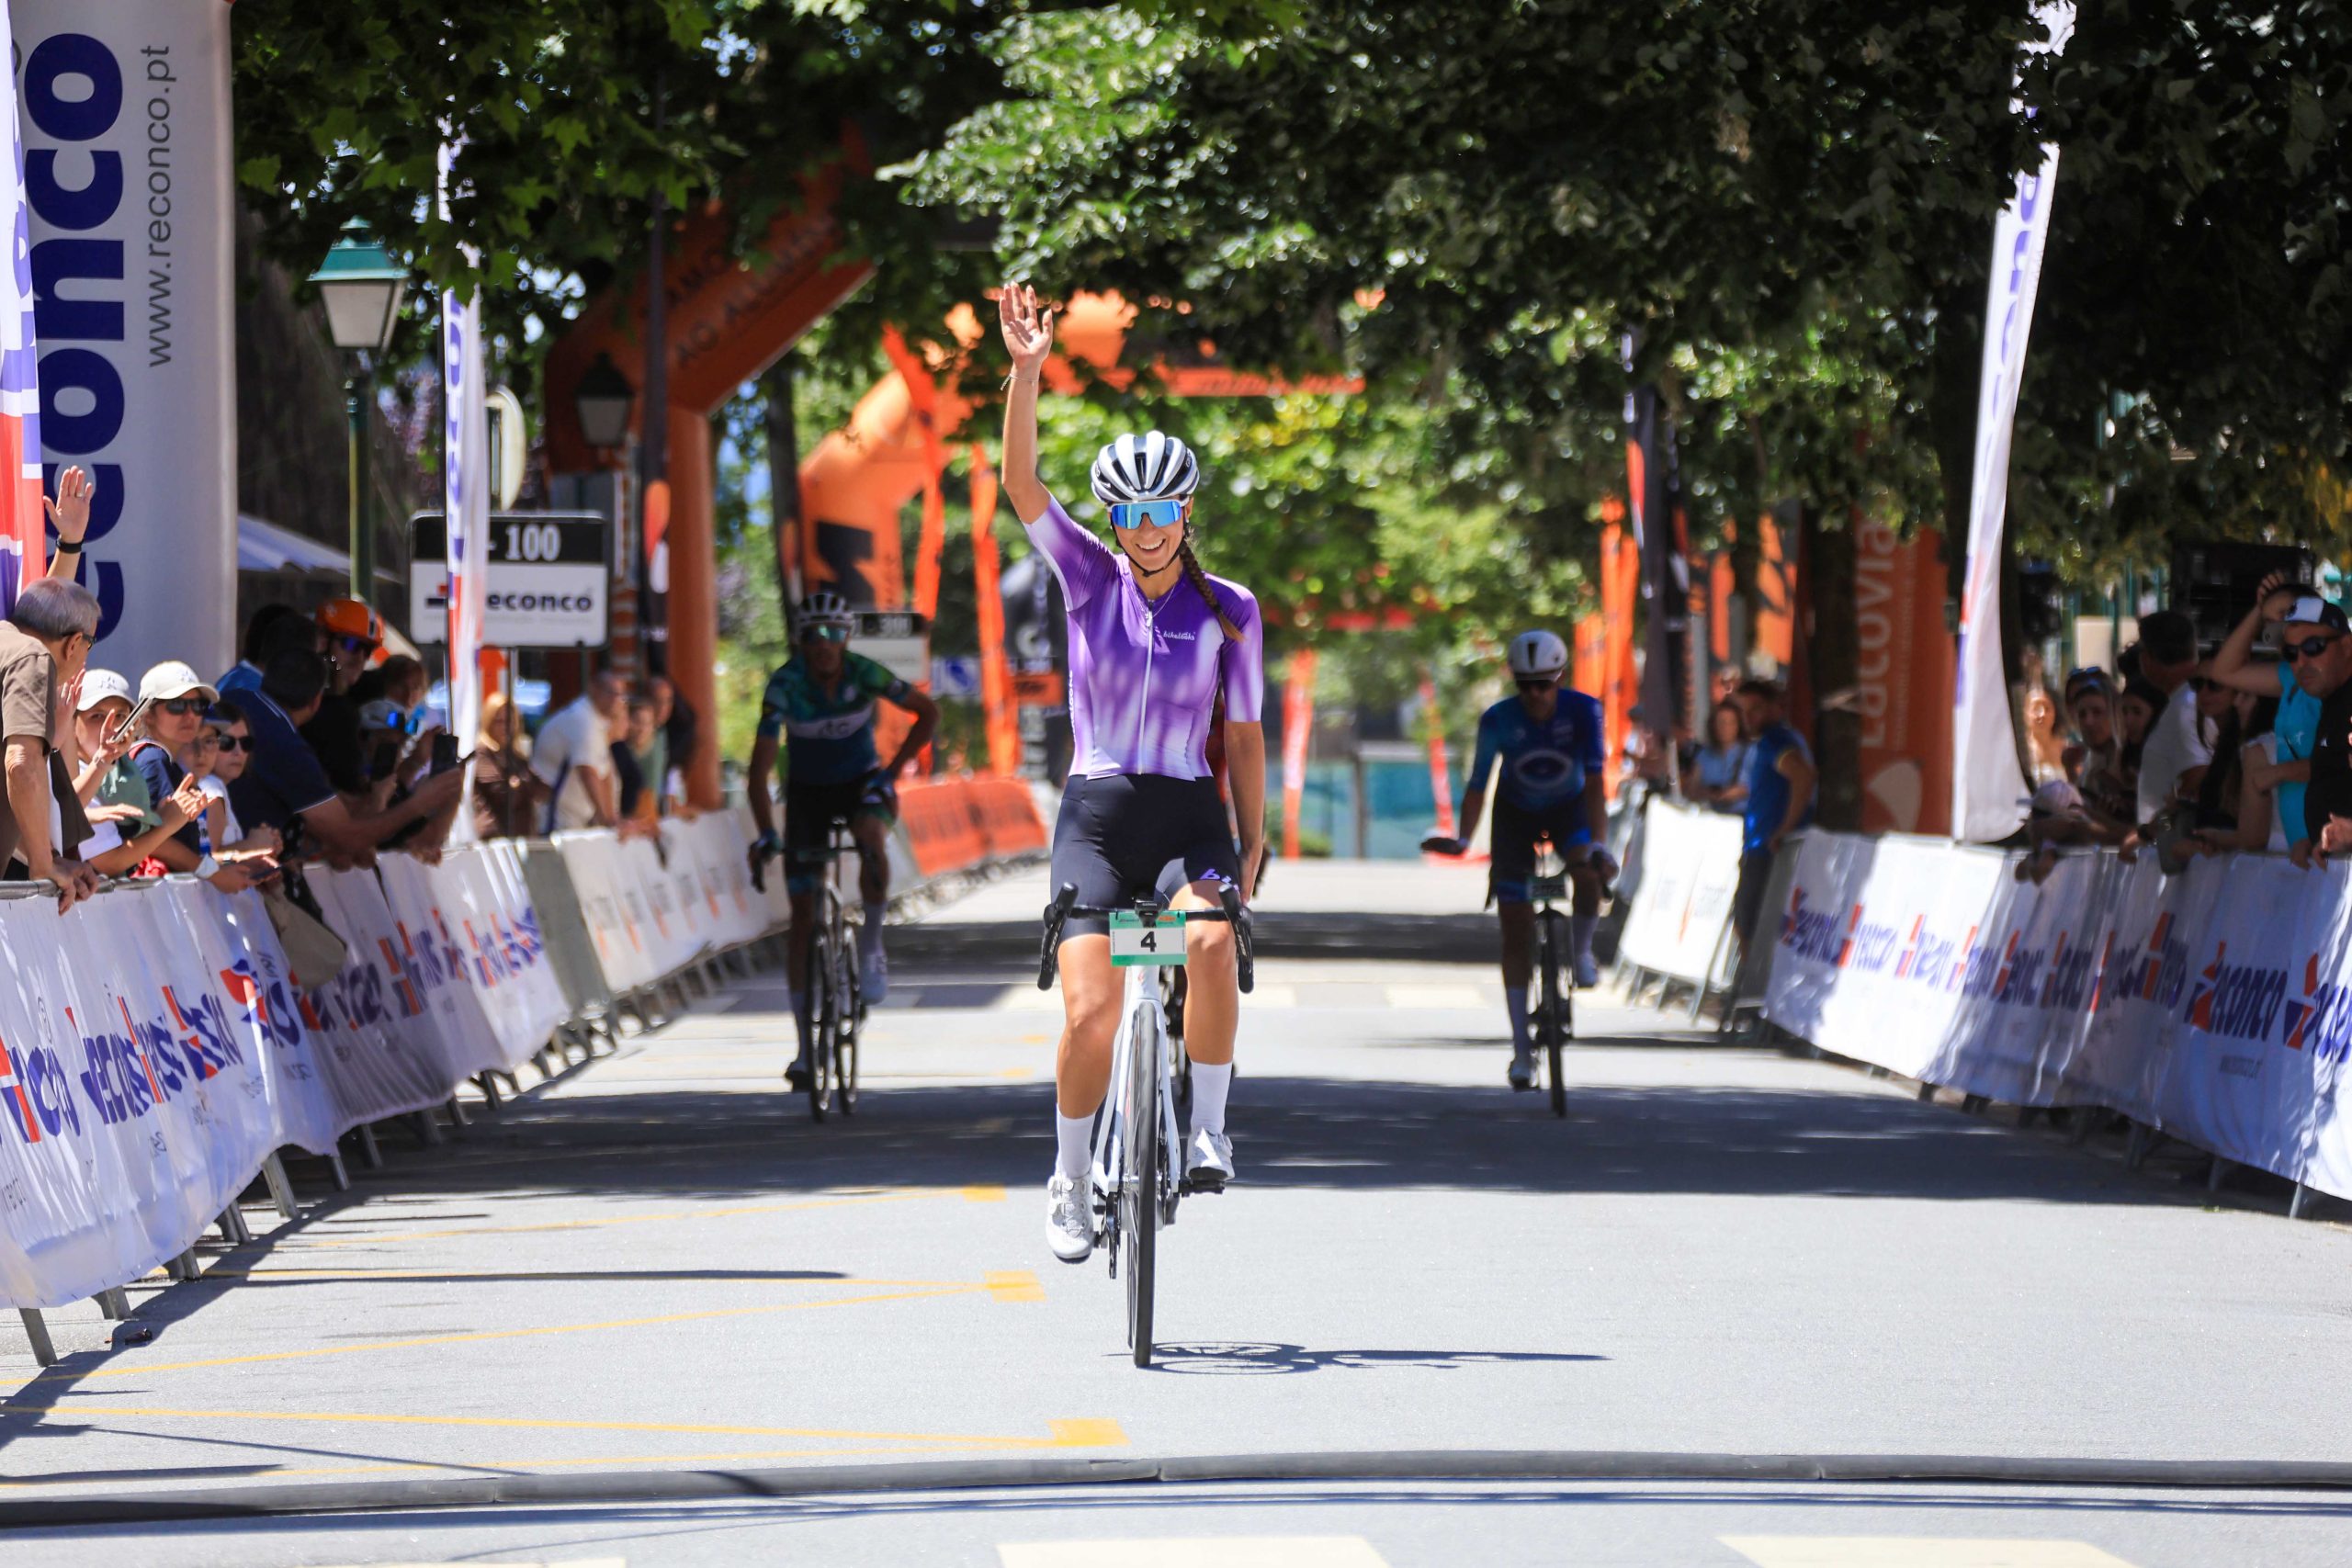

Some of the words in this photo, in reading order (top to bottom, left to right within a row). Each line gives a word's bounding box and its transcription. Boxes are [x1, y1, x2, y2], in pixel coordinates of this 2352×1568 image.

[140, 45, 177, 367] www.reconco.pt
[506, 524, 561, 562] 100
[486, 593, 593, 613] econco
[1140, 931, 1157, 953] 4
